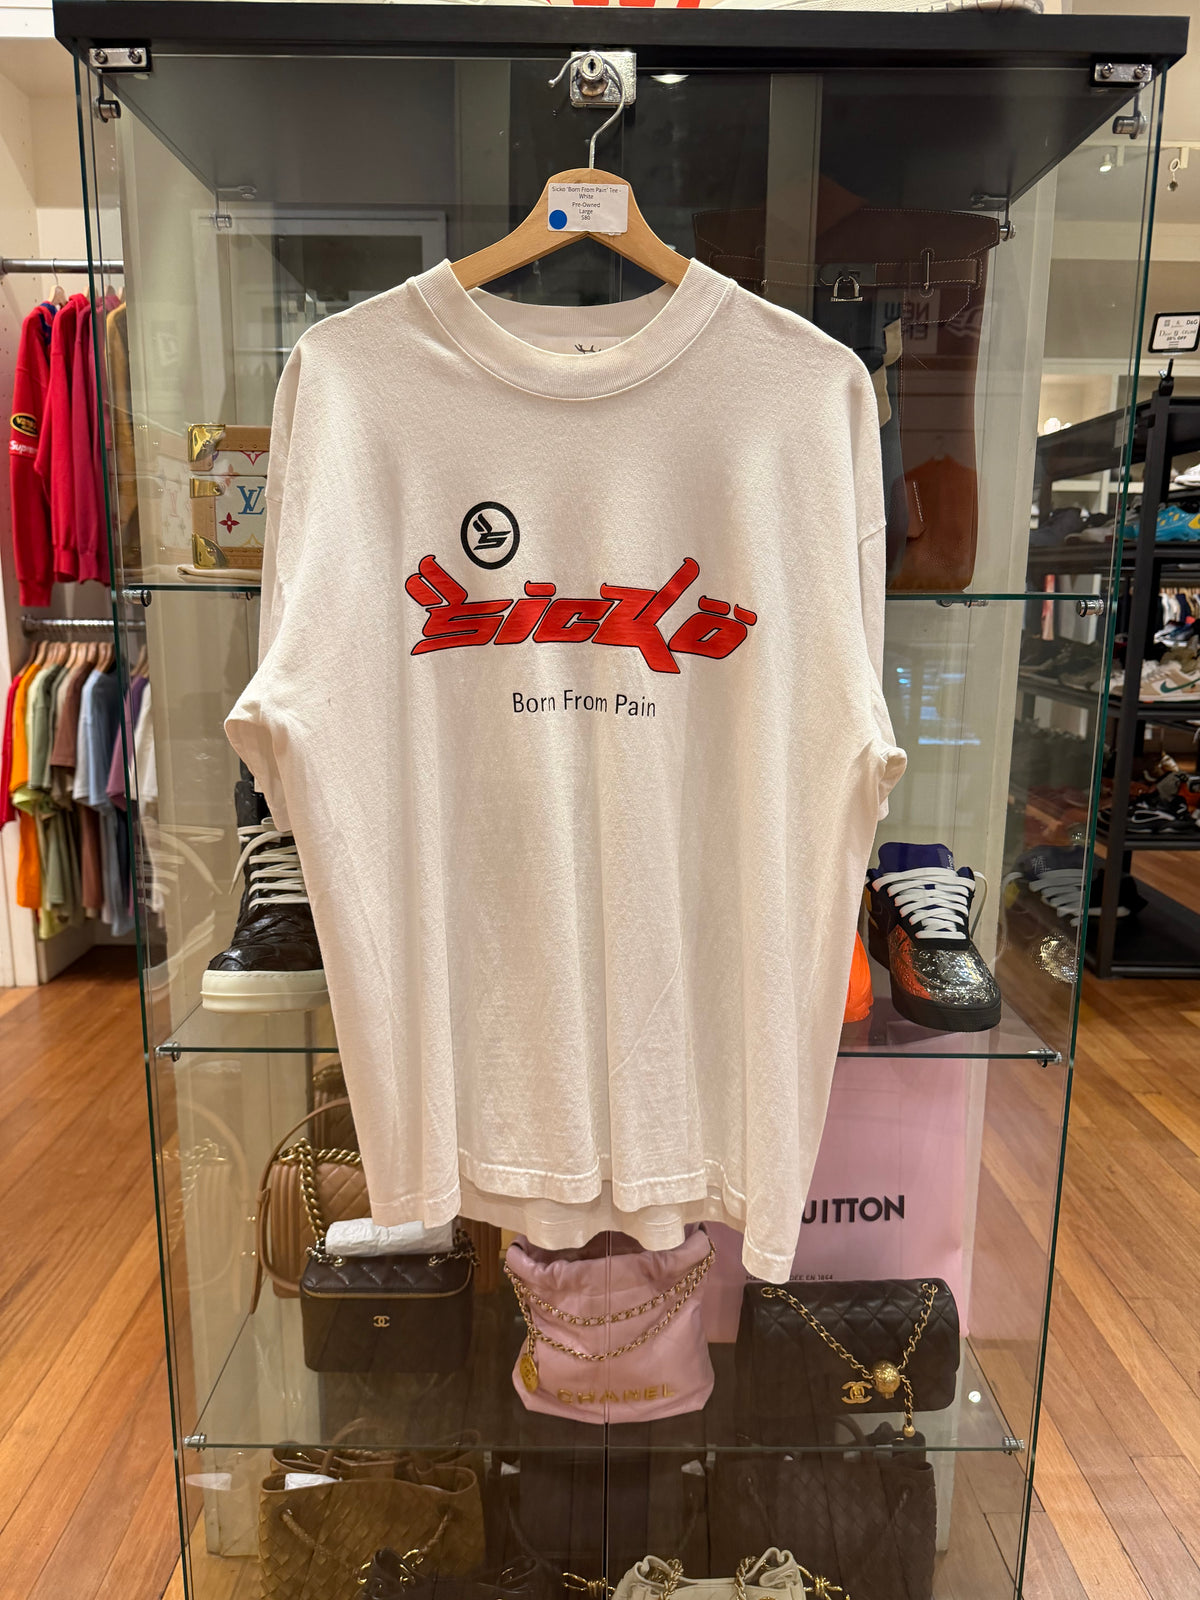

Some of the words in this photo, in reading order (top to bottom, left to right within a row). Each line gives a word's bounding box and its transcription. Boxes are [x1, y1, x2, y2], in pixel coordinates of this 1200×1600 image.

[512, 692, 556, 713] Born
[563, 689, 608, 713] From
[615, 693, 656, 717] Pain
[802, 1194, 905, 1224] UITTON
[556, 1384, 676, 1405] CHANEL
